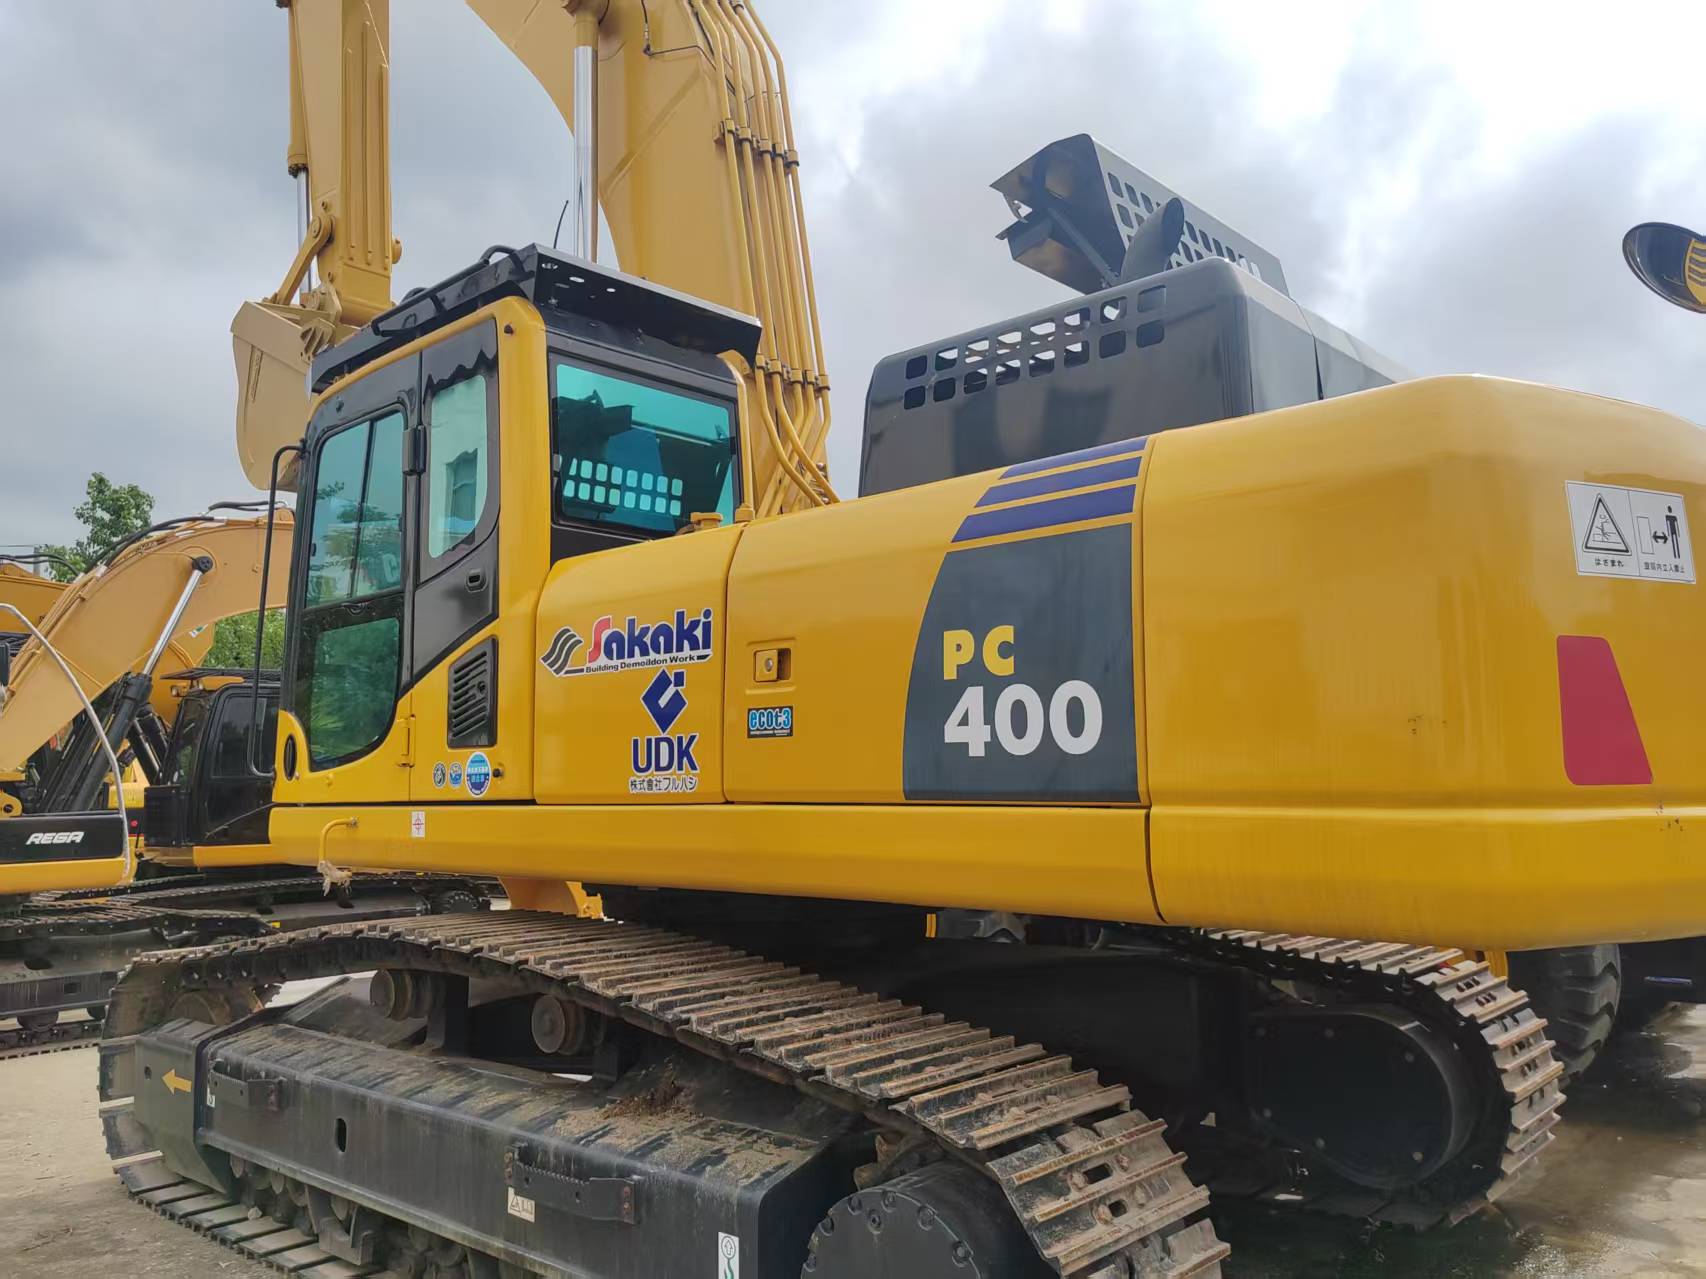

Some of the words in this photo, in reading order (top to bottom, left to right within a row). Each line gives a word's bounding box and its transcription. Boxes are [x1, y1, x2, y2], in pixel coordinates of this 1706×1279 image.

[588, 608, 712, 663] Sakaki
[669, 655, 696, 664] Work
[943, 624, 1015, 680] PC
[944, 680, 1103, 757] 400
[633, 735, 698, 773] UDK
